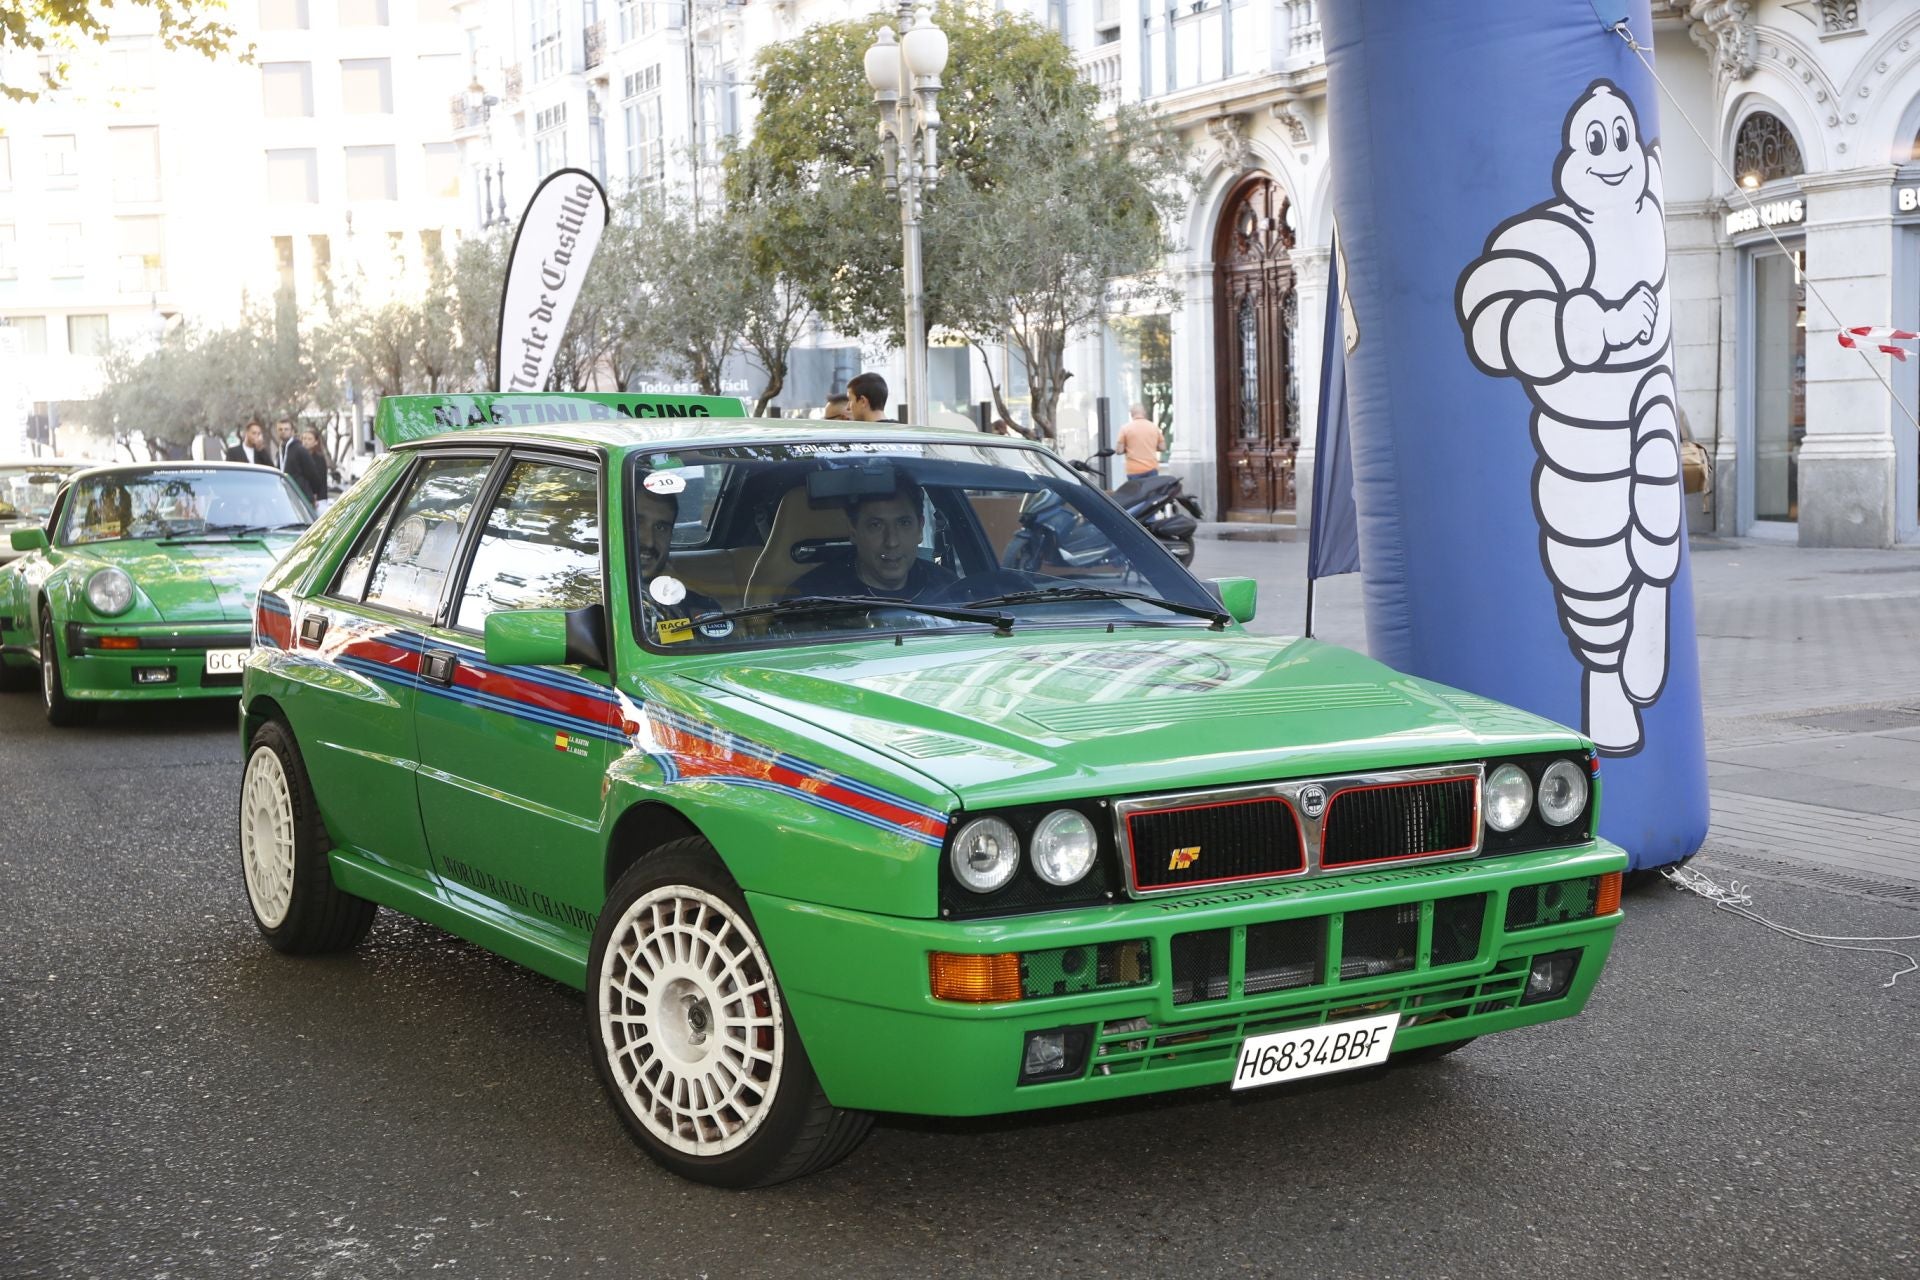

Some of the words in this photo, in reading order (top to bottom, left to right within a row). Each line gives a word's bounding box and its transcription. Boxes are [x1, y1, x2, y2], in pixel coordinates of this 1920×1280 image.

[1898, 188, 1920, 211] B
[1761, 200, 1803, 226] KING
[541, 184, 594, 291] Castilla
[529, 294, 557, 323] de
[639, 381, 671, 393] Todo
[673, 383, 689, 392] es
[720, 379, 749, 392] fácil
[433, 403, 579, 428] MARTINI
[589, 402, 710, 421] RACING
[793, 444, 848, 453] Talleres
[849, 443, 897, 452] MOTOR
[659, 479, 674, 487] 10
[210, 653, 232, 669] GC
[1168, 846, 1201, 870] HF
[443, 856, 487, 890] WORLD
[487, 873, 530, 908] RALLY
[1153, 891, 1256, 913] WORLD
[1256, 878, 1346, 899] RALLY
[1349, 863, 1487, 886] CHAMPION
[1239, 1026, 1388, 1081] H6834BBF
